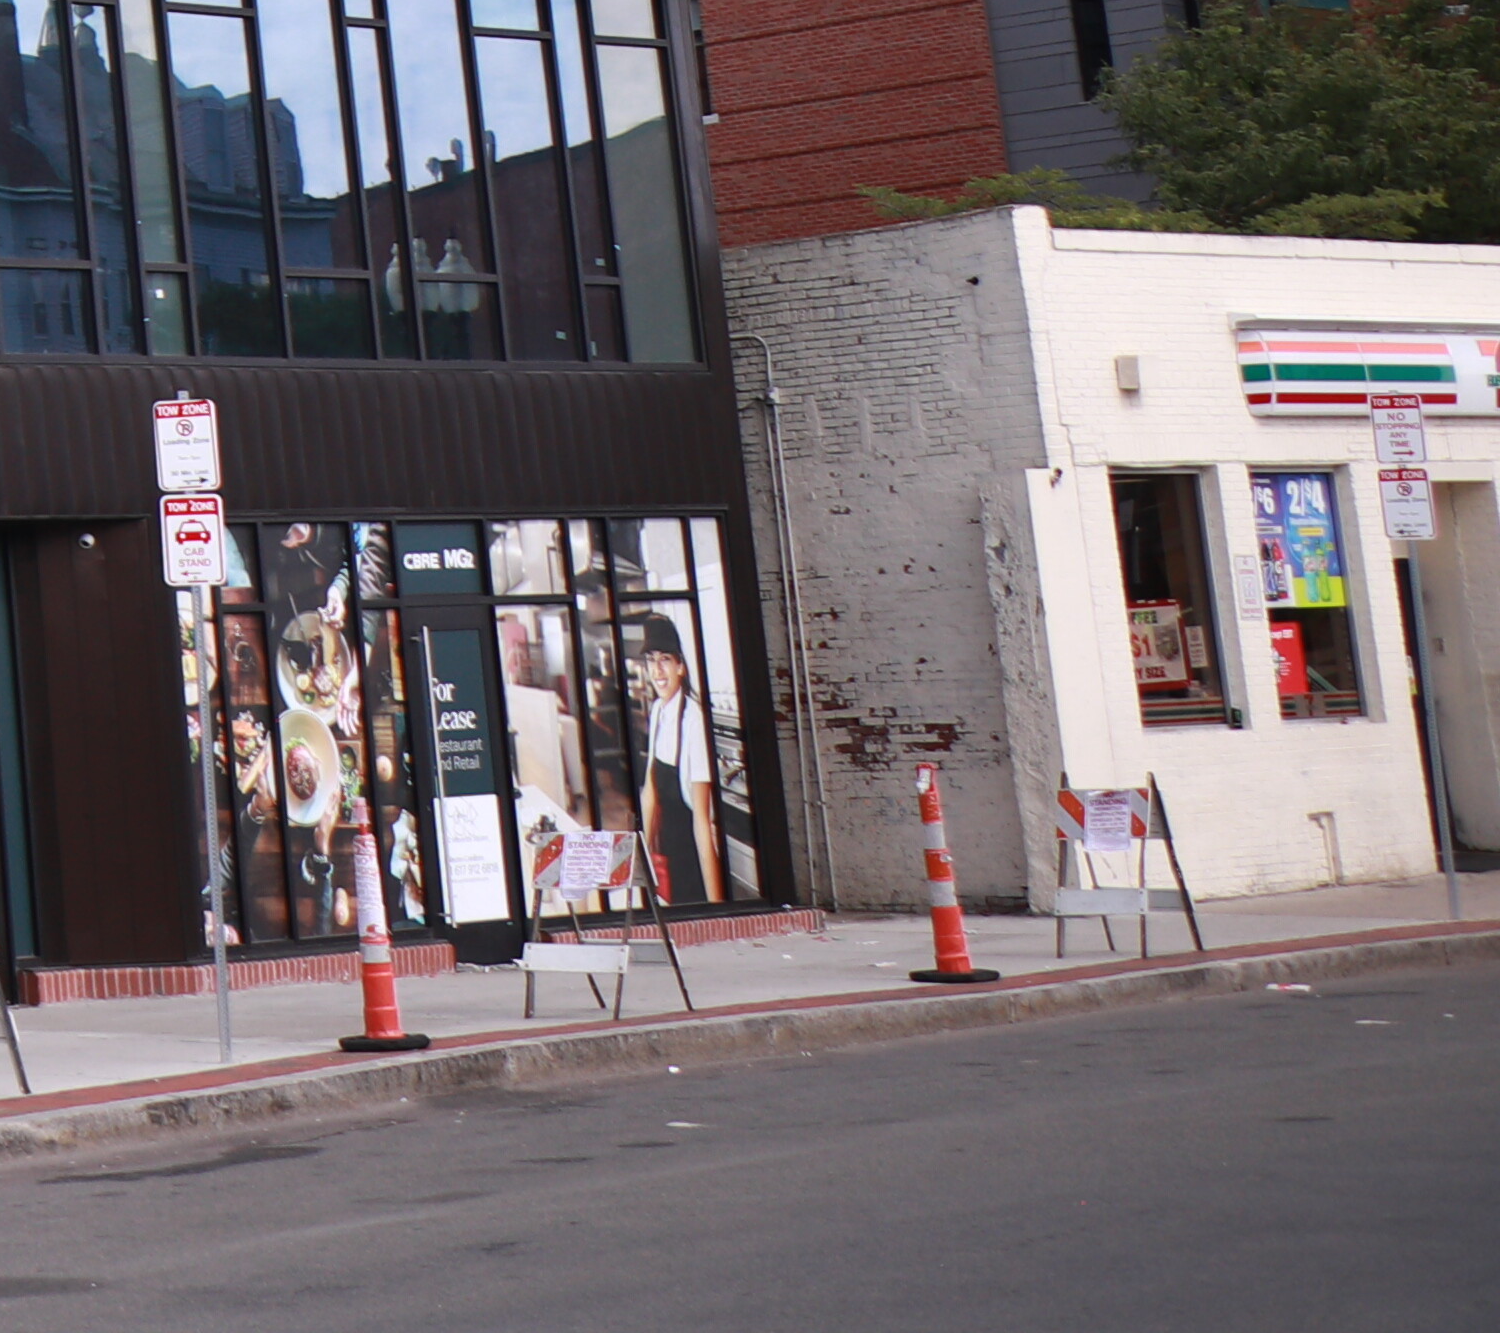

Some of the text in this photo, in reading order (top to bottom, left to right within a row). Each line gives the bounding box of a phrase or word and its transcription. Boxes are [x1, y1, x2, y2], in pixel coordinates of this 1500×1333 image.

[1373, 397, 1417, 406] TOW ZONE
[156, 403, 210, 417] TOW ZONE
[1387, 412, 1405, 421] NO
[1375, 422, 1420, 430] STOPPING
[1380, 470, 1426, 480] TOW ZONE
[166, 500, 216, 512] TOW ZONE
[183, 547, 205, 556] CAB
[178, 558, 212, 567] STAND
[403, 547, 476, 571] CBRE MG2
[1145, 666, 1168, 679] SIZE
[438, 738, 484, 752] estaurant
[440, 754, 481, 771] nd Retail
[1089, 797, 1127, 806] STANDING
[568, 841, 609, 849] STANDING
